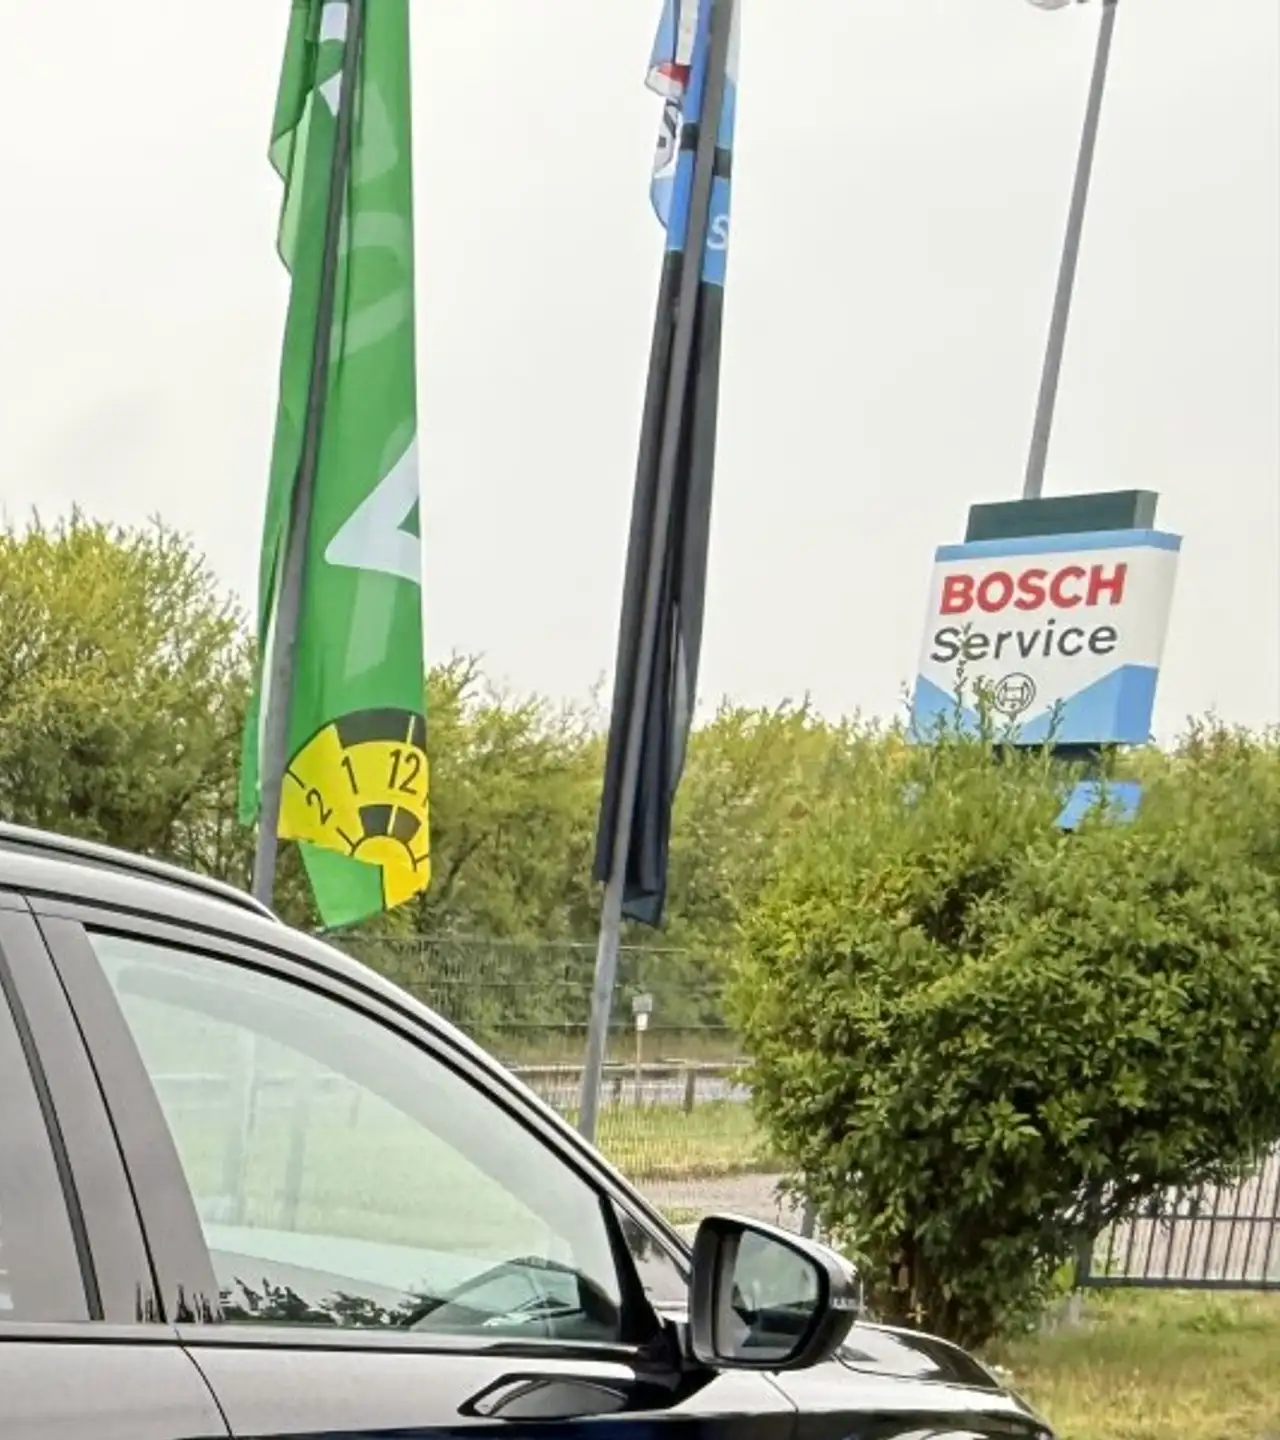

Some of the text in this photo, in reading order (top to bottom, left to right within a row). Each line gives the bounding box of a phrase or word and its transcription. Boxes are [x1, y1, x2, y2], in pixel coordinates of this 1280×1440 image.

[940, 562, 1128, 615] BOSCH
[930, 618, 1118, 664] Service
[305, 748, 421, 825] 2 1 12
